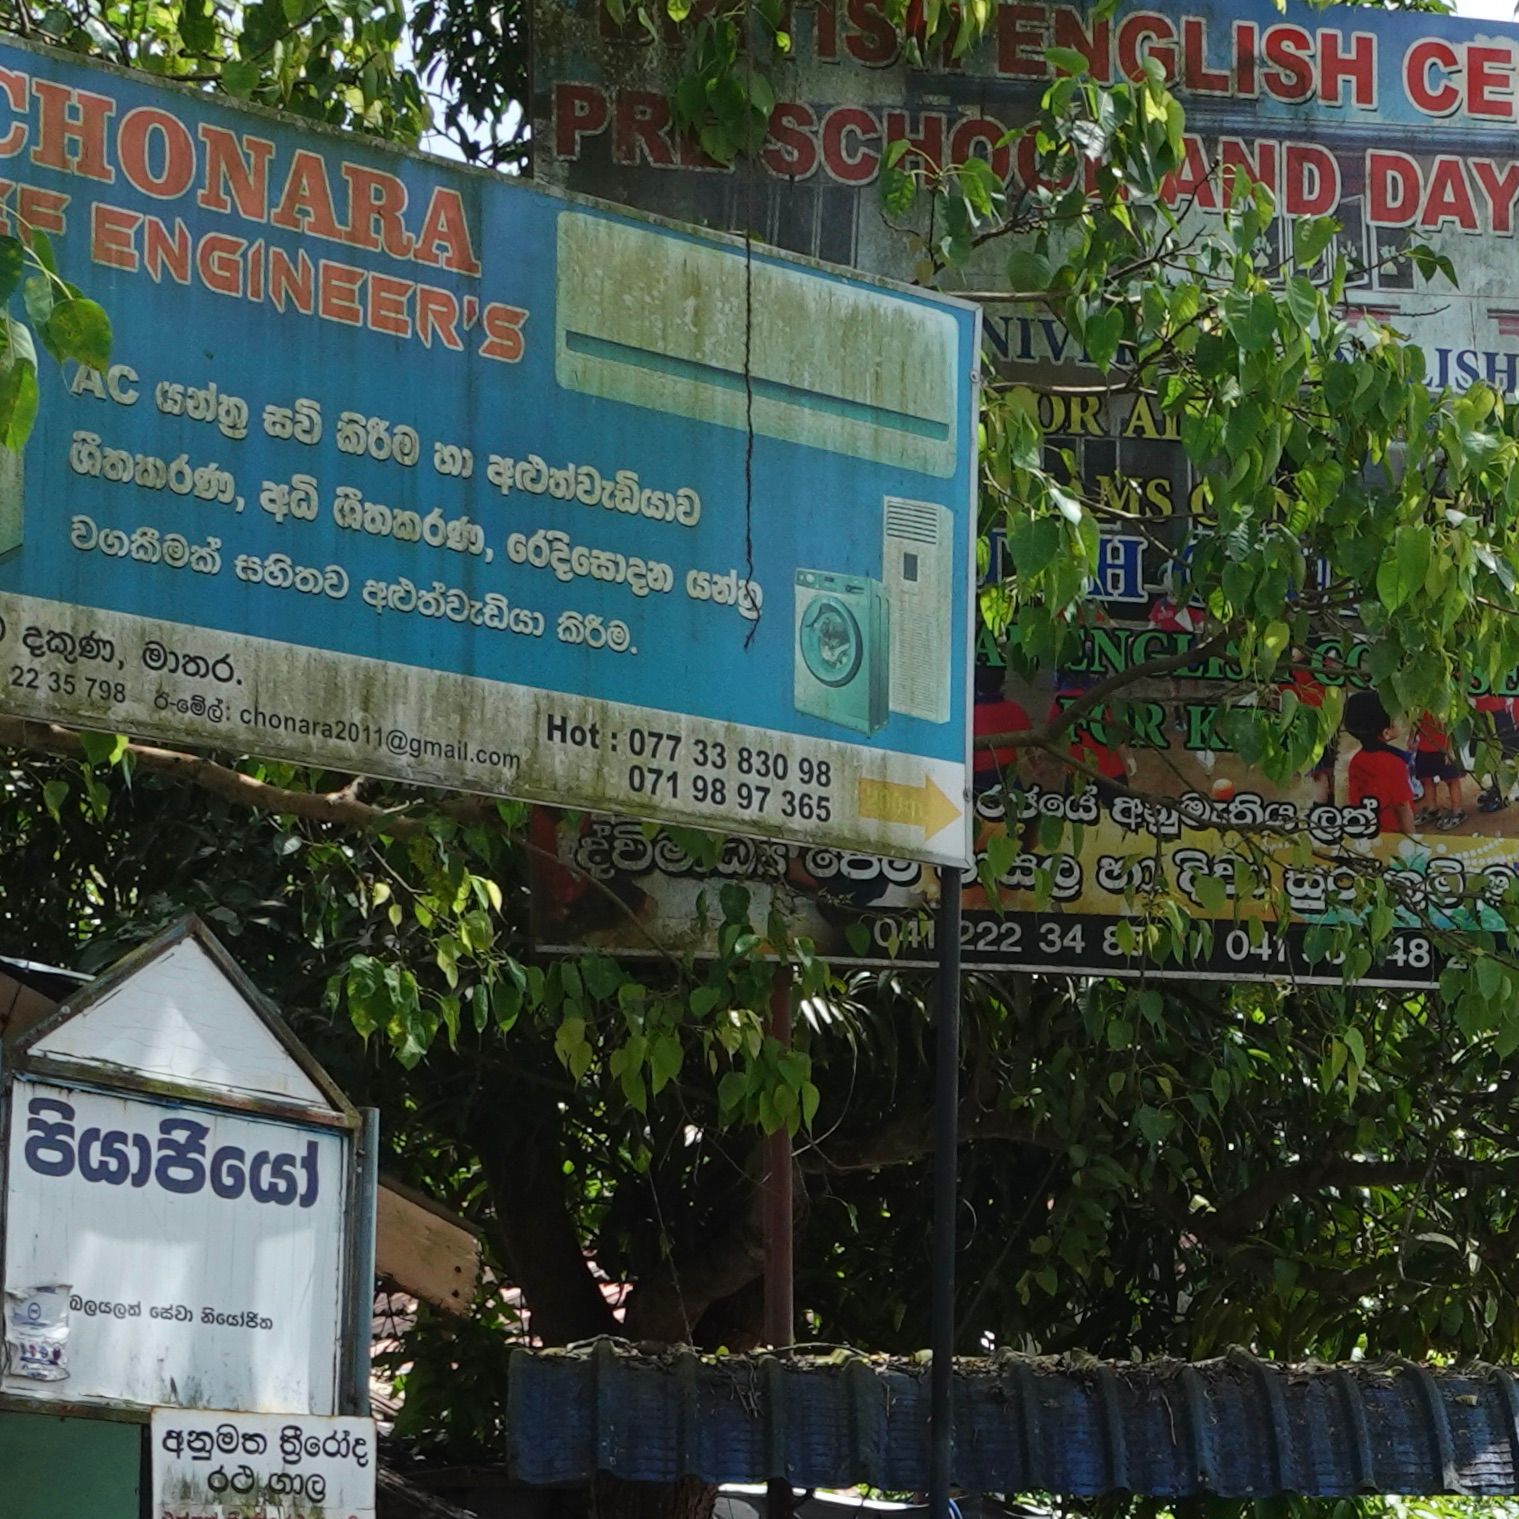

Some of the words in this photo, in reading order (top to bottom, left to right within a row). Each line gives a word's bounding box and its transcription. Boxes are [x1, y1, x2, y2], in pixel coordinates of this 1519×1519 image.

[999, 2, 1378, 110] ENGLISH
[551, 82, 735, 175] PR
[758, 100, 1145, 205] SCHOO
[1163, 133, 1341, 219] AND
[91, 200, 530, 364] ENGINEER'S
[72, 364, 139, 405] AC
[434, 441, 474, 479] හා
[234, 553, 349, 599] සහිතව
[142, 641, 243, 686] මාතර.
[11, 666, 39, 690] 22
[49, 672, 76, 695] 35
[85, 677, 127, 703] 798
[240, 706, 521, 770] chonara2011@gmail.com
[547, 714, 599, 749] Hot
[629, 729, 682, 762] 077
[693, 740, 727, 769] 33
[738, 747, 788, 780] 830
[799, 758, 831, 787] 98
[629, 766, 679, 799] 071
[692, 775, 726, 805] 98
[737, 783, 771, 813] 97
[781, 790, 831, 822] 365
[1039, 922, 1086, 954] 34
[162, 1423, 268, 1461] අනුමත
[268, 1470, 327, 1504] ගාල
